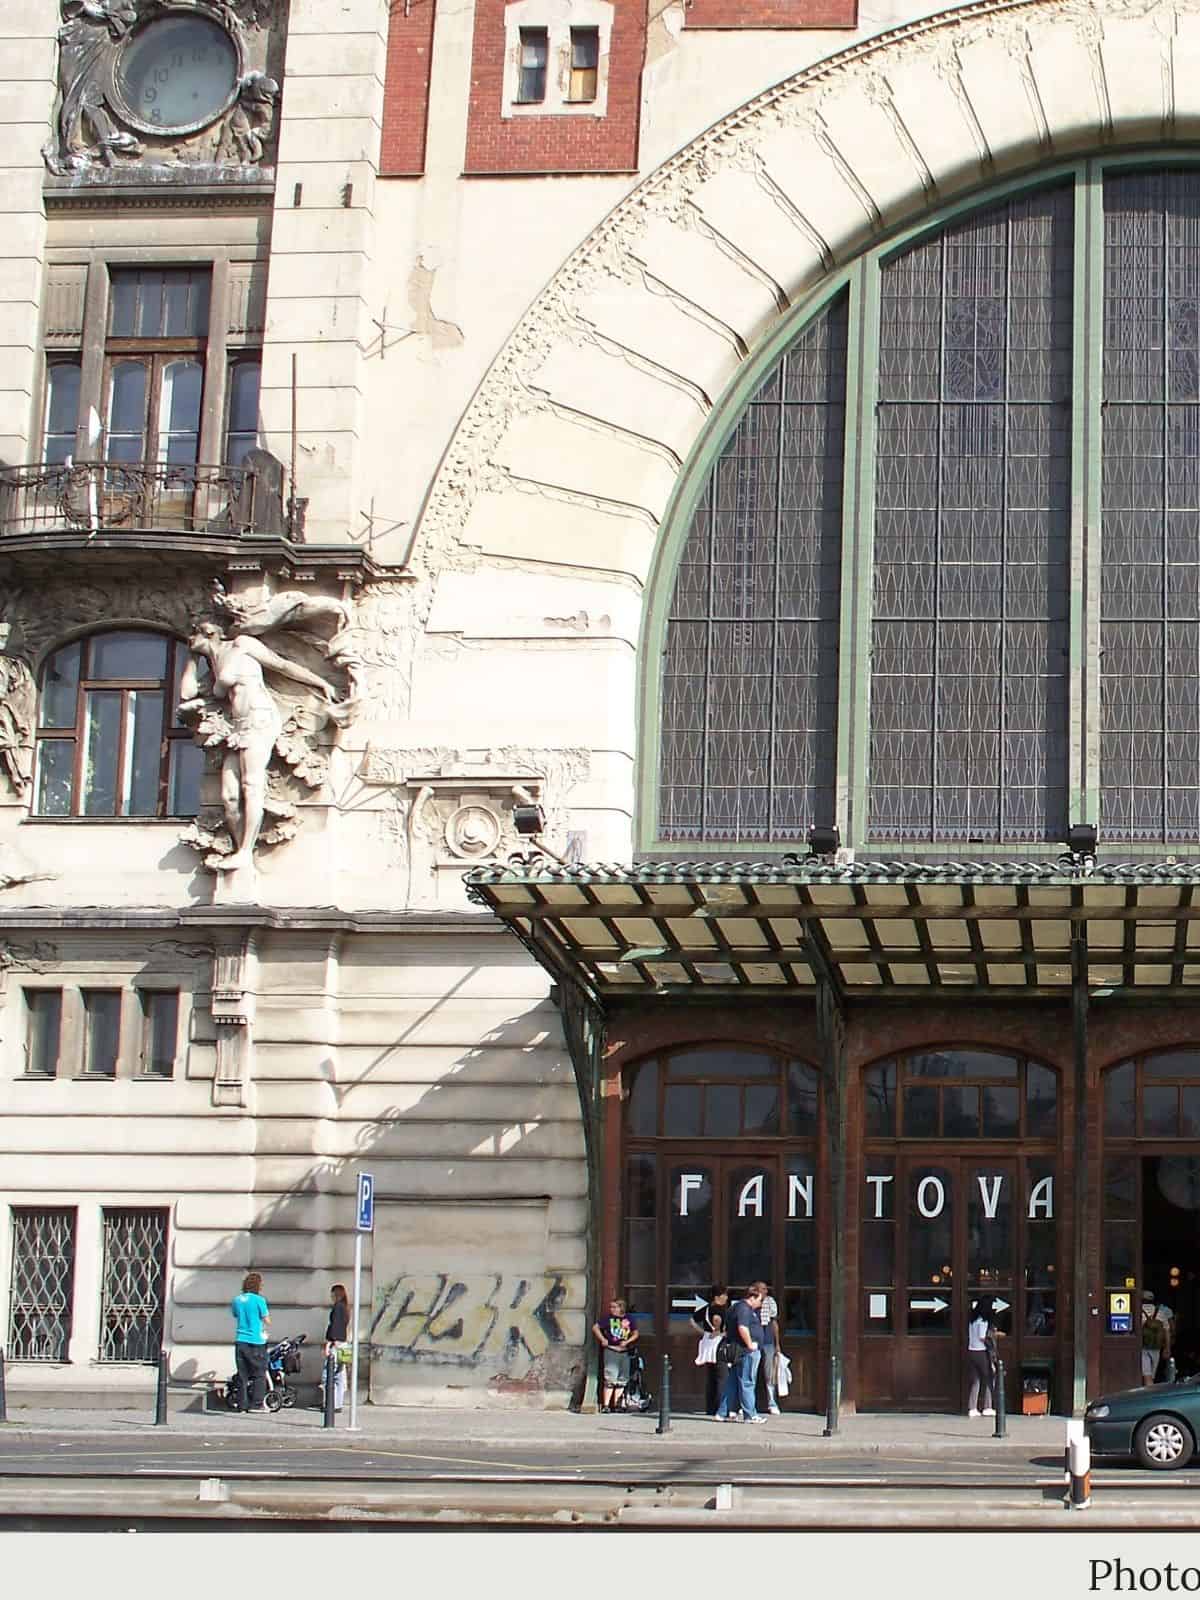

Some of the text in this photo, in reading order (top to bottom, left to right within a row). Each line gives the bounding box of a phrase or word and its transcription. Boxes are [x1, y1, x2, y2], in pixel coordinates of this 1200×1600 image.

[171, 54, 183, 67] 11
[154, 69, 169, 83] 10
[144, 88, 157, 104] 9
[151, 108, 162, 122] 8
[361, 1179, 371, 1212] P
[680, 1173, 1054, 1218] FANTOVA
